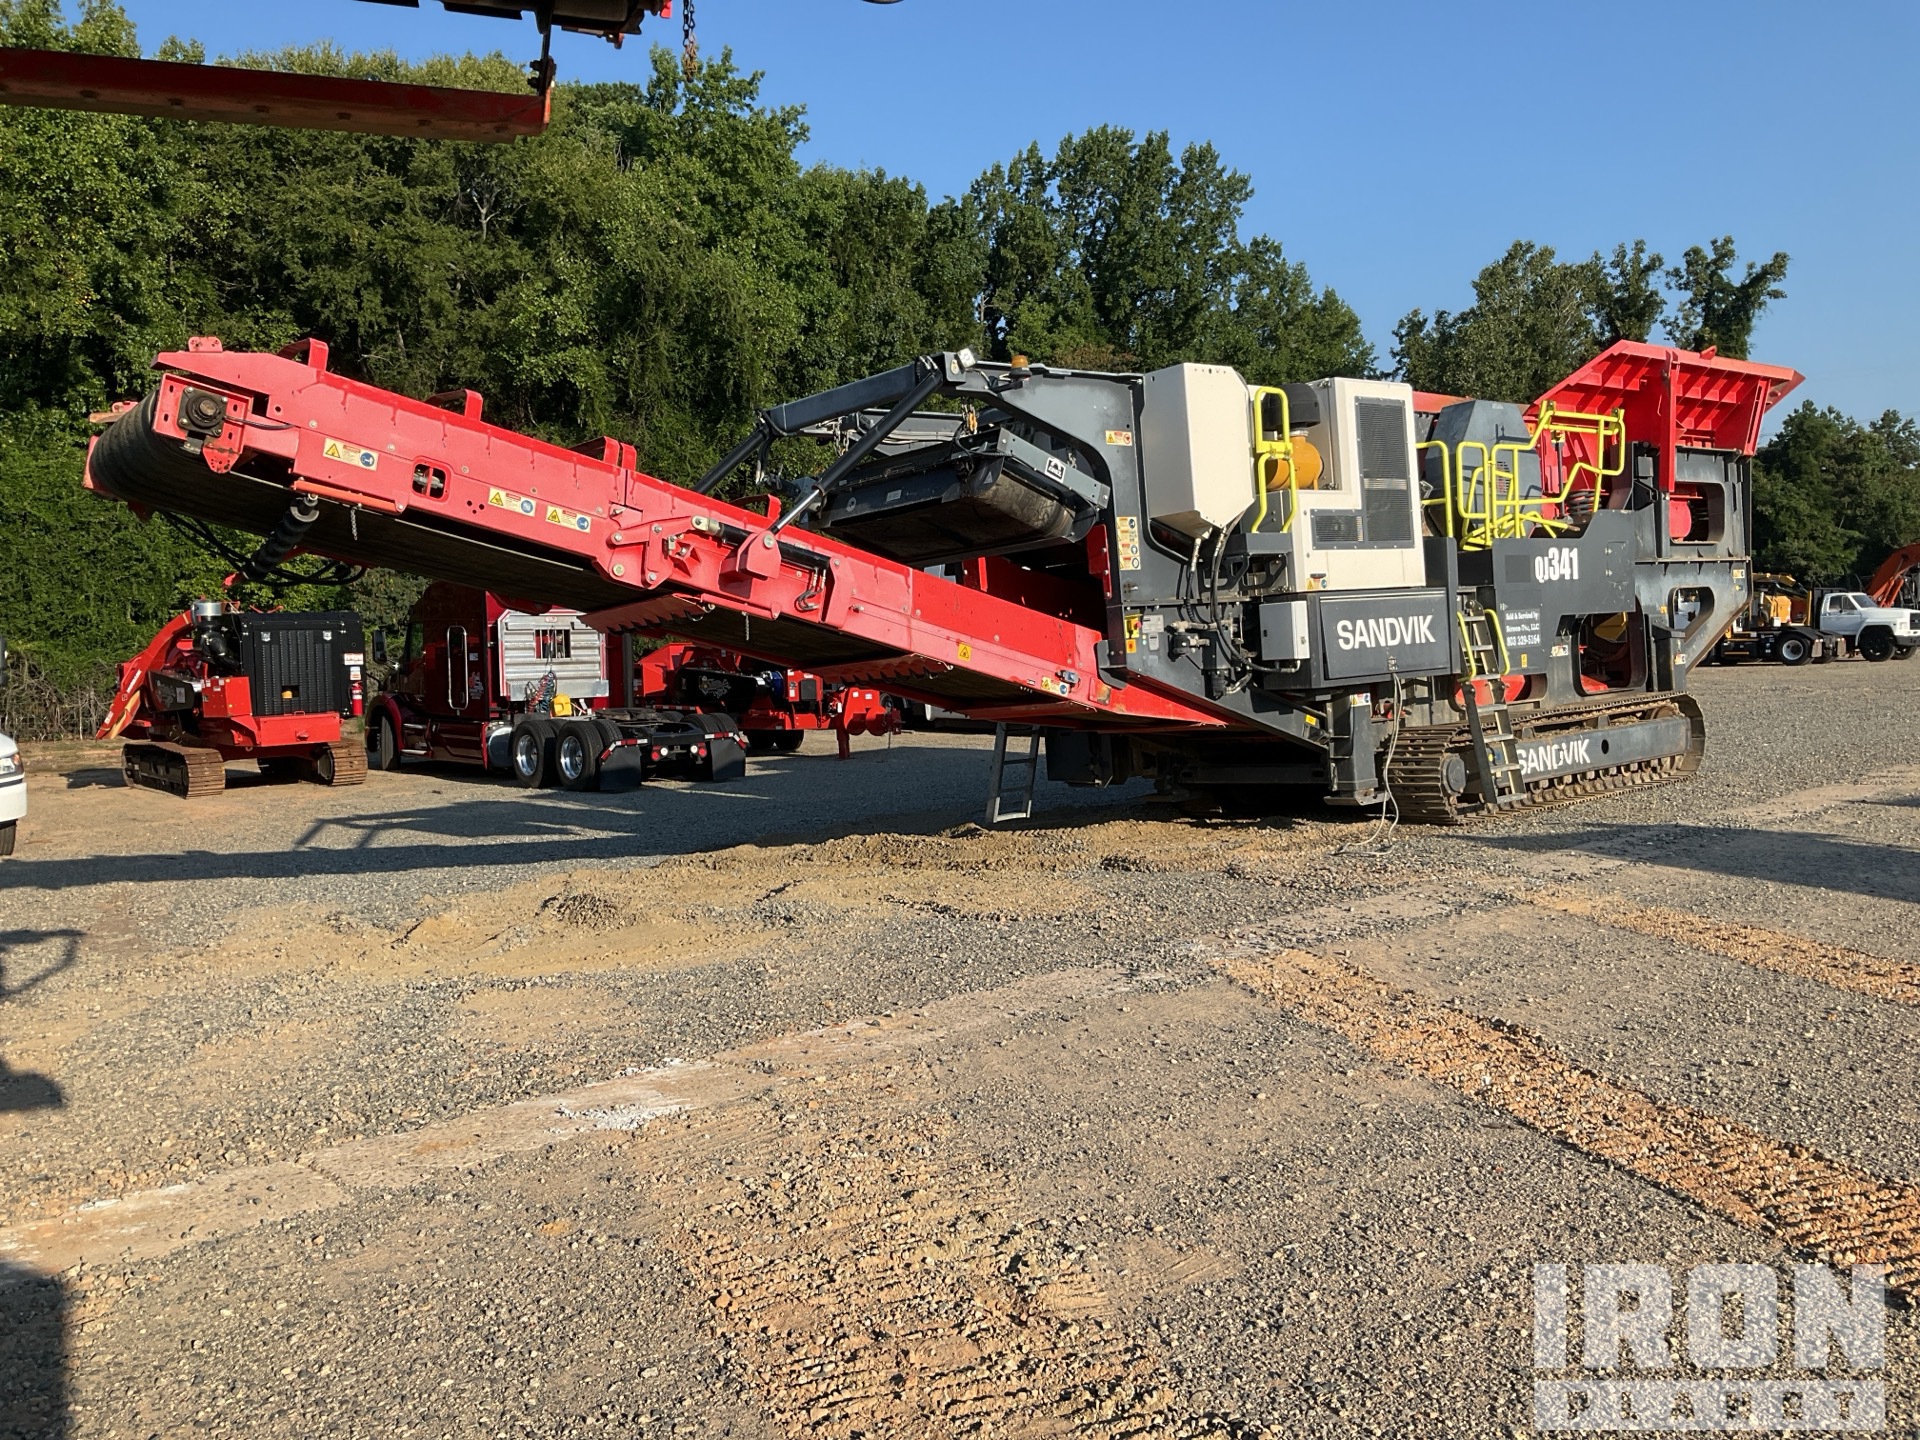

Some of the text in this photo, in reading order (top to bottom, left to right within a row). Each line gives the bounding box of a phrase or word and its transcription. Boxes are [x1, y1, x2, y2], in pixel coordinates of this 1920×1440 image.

[1534, 547, 1579, 583] QJ341
[1336, 614, 1436, 650] SANDVIK
[1530, 623, 1540, 631] LLC
[1516, 738, 1591, 775] SANDVIK
